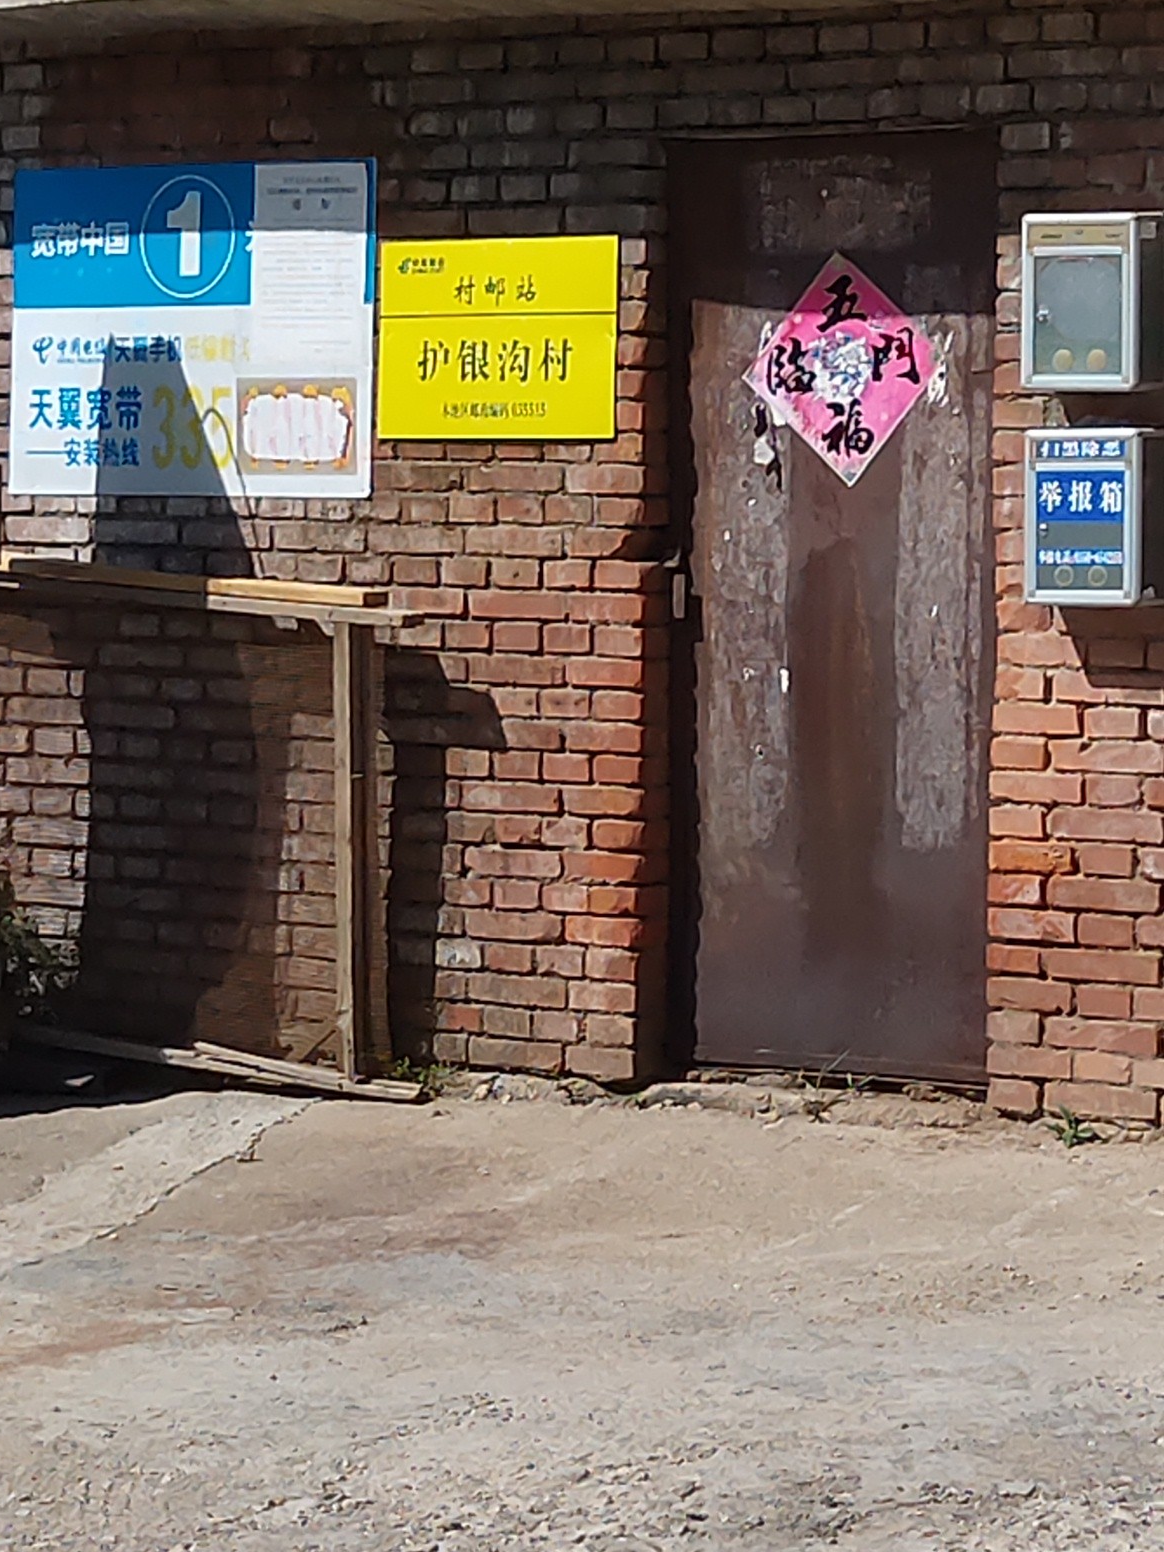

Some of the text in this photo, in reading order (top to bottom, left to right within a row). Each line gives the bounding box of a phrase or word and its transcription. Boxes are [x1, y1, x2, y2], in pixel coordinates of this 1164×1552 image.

[31, 221, 130, 257] 宽带中国
[167, 190, 202, 277] 1
[454, 274, 538, 306] 村邮站
[816, 274, 868, 332] 五
[418, 338, 574, 383] 护银沟村
[29, 386, 143, 431] 天翼宽带
[822, 398, 874, 458] 福
[1039, 480, 1123, 513] 举报箱
